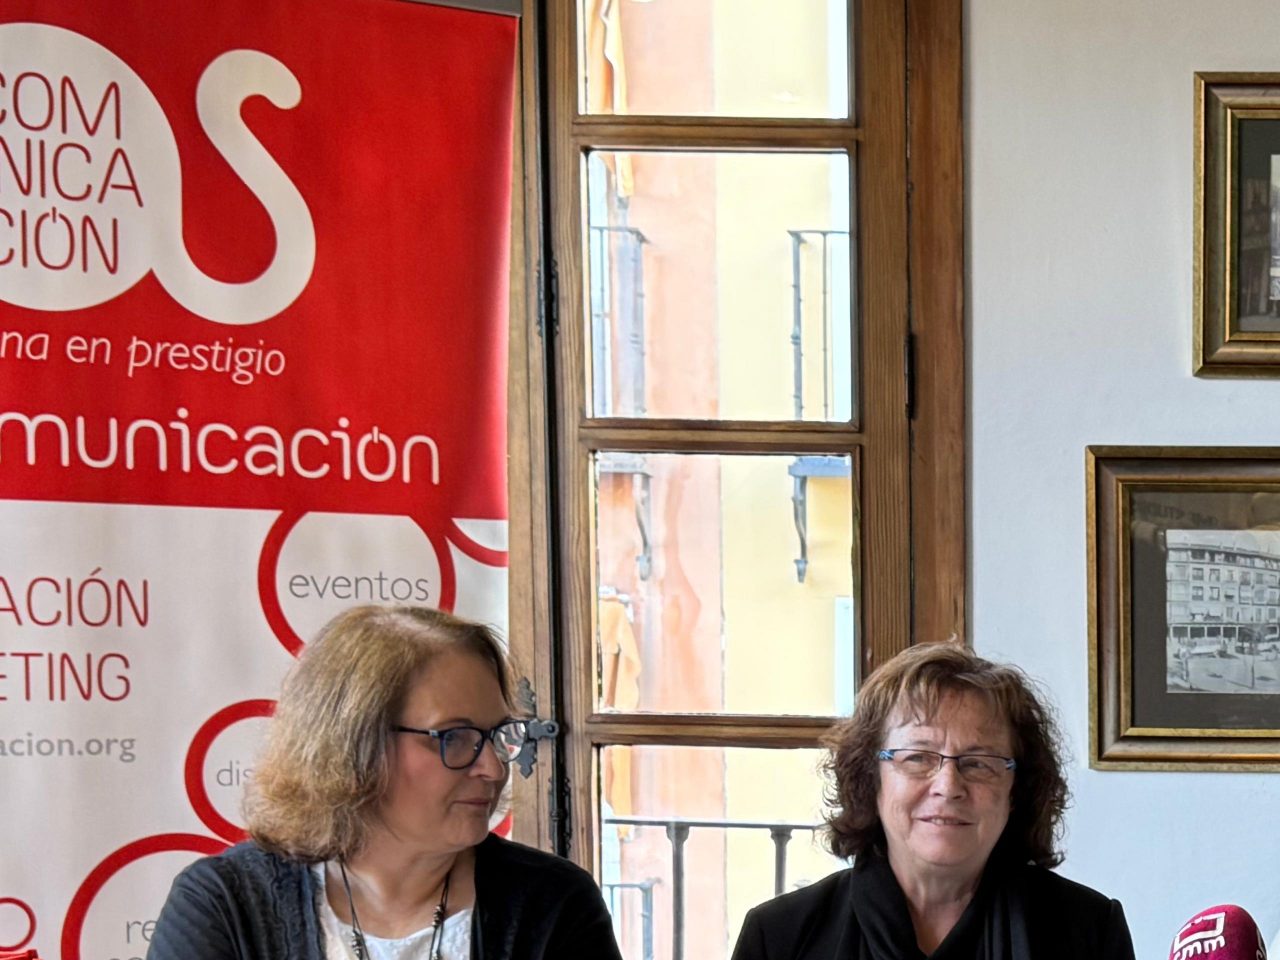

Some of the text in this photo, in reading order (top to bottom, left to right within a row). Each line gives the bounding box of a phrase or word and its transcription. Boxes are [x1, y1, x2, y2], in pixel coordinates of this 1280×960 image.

[0, 70, 122, 141] OM
[66, 336, 112, 365] en
[127, 336, 286, 385] prestigio
[288, 568, 430, 602] eventos
